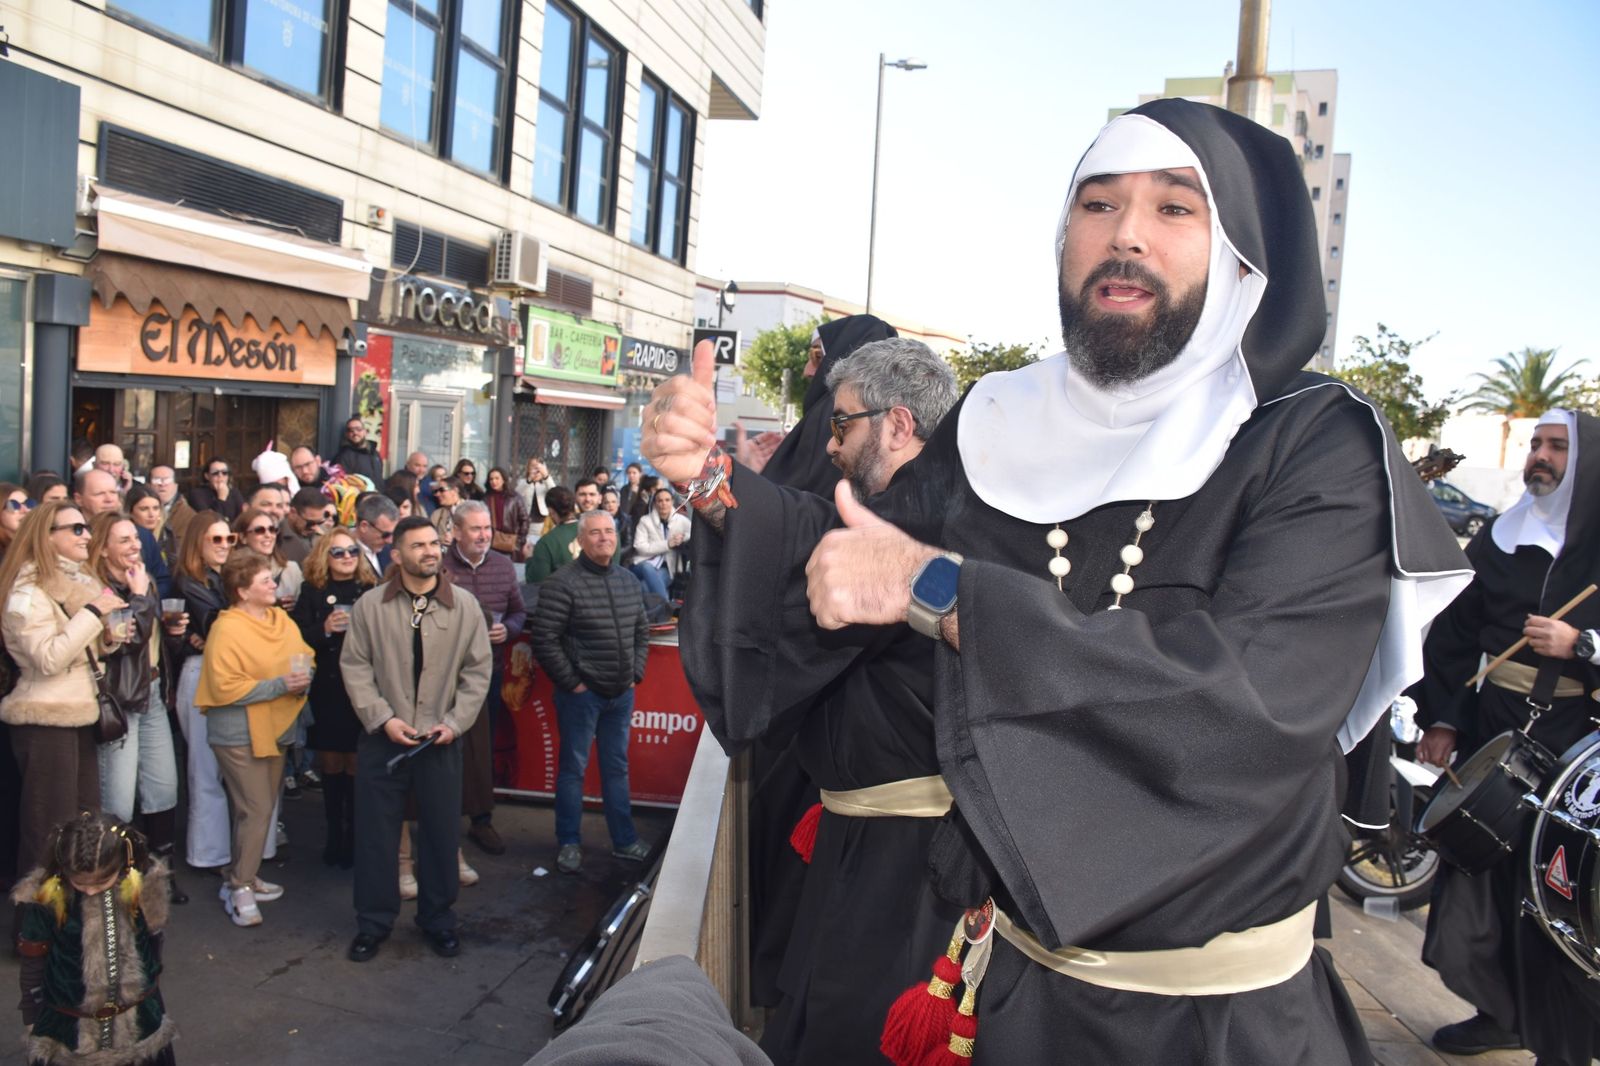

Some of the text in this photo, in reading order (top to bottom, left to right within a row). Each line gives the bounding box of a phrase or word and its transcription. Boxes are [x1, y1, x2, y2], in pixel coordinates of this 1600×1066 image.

[140, 311, 297, 372] El Mesón
[713, 335, 734, 360] R
[631, 710, 697, 734] ampo
